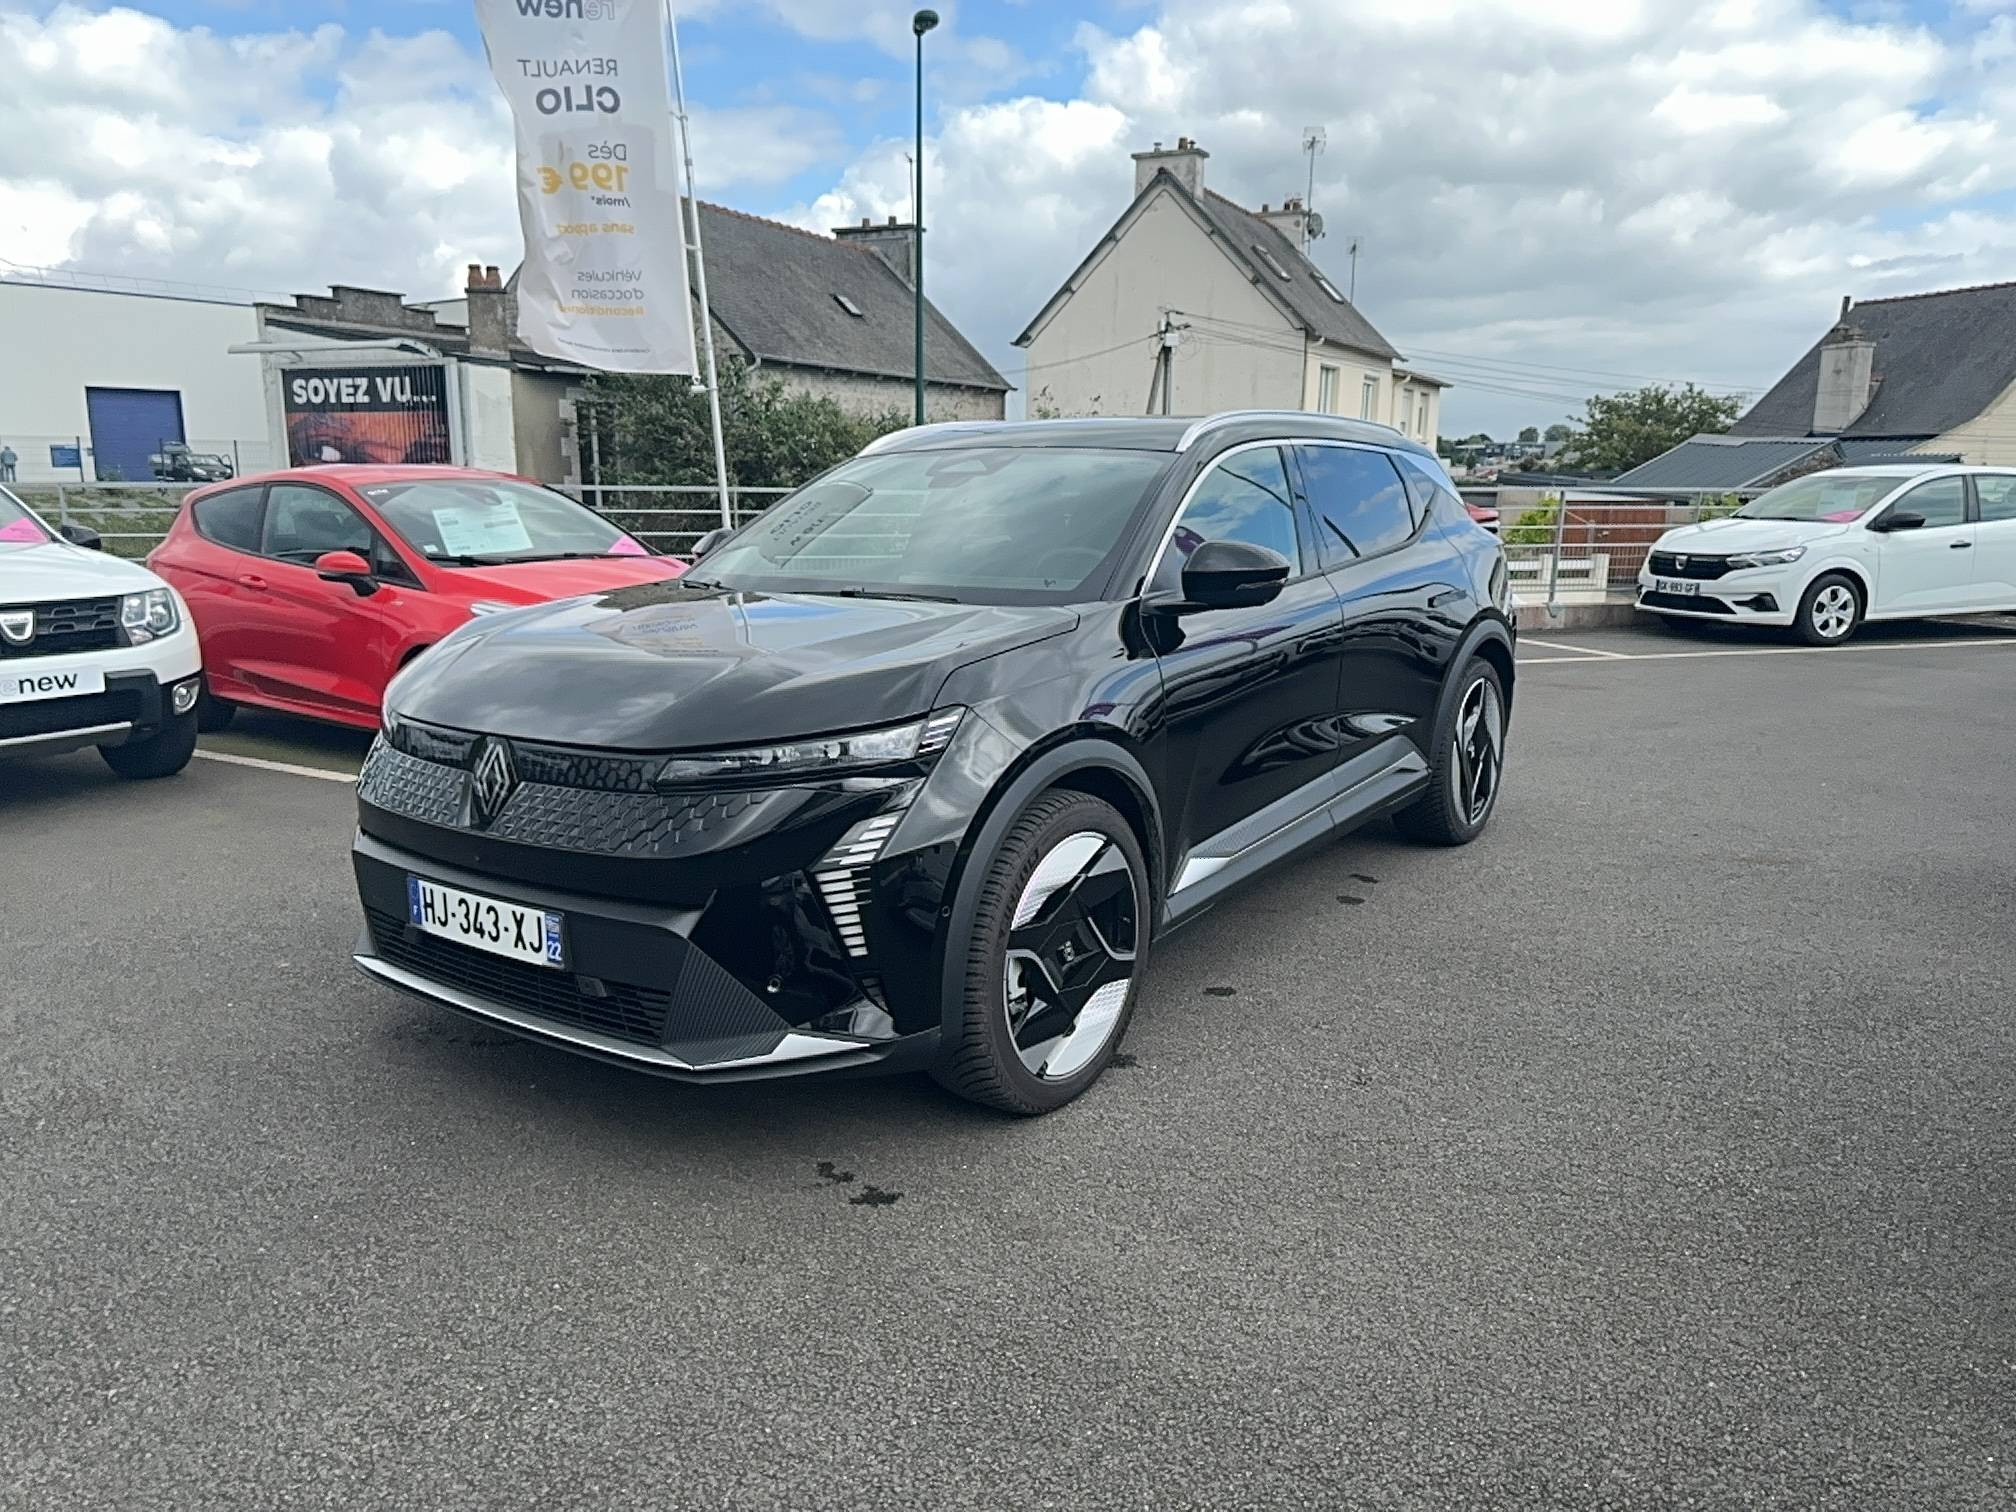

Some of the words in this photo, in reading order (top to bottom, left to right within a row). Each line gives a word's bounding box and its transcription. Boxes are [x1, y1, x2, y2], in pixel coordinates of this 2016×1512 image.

[292, 377, 370, 404] SOYEZ
[0, 673, 77, 697] enew
[422, 887, 543, 953] HJ-343-XJ
[547, 941, 562, 961] 22
